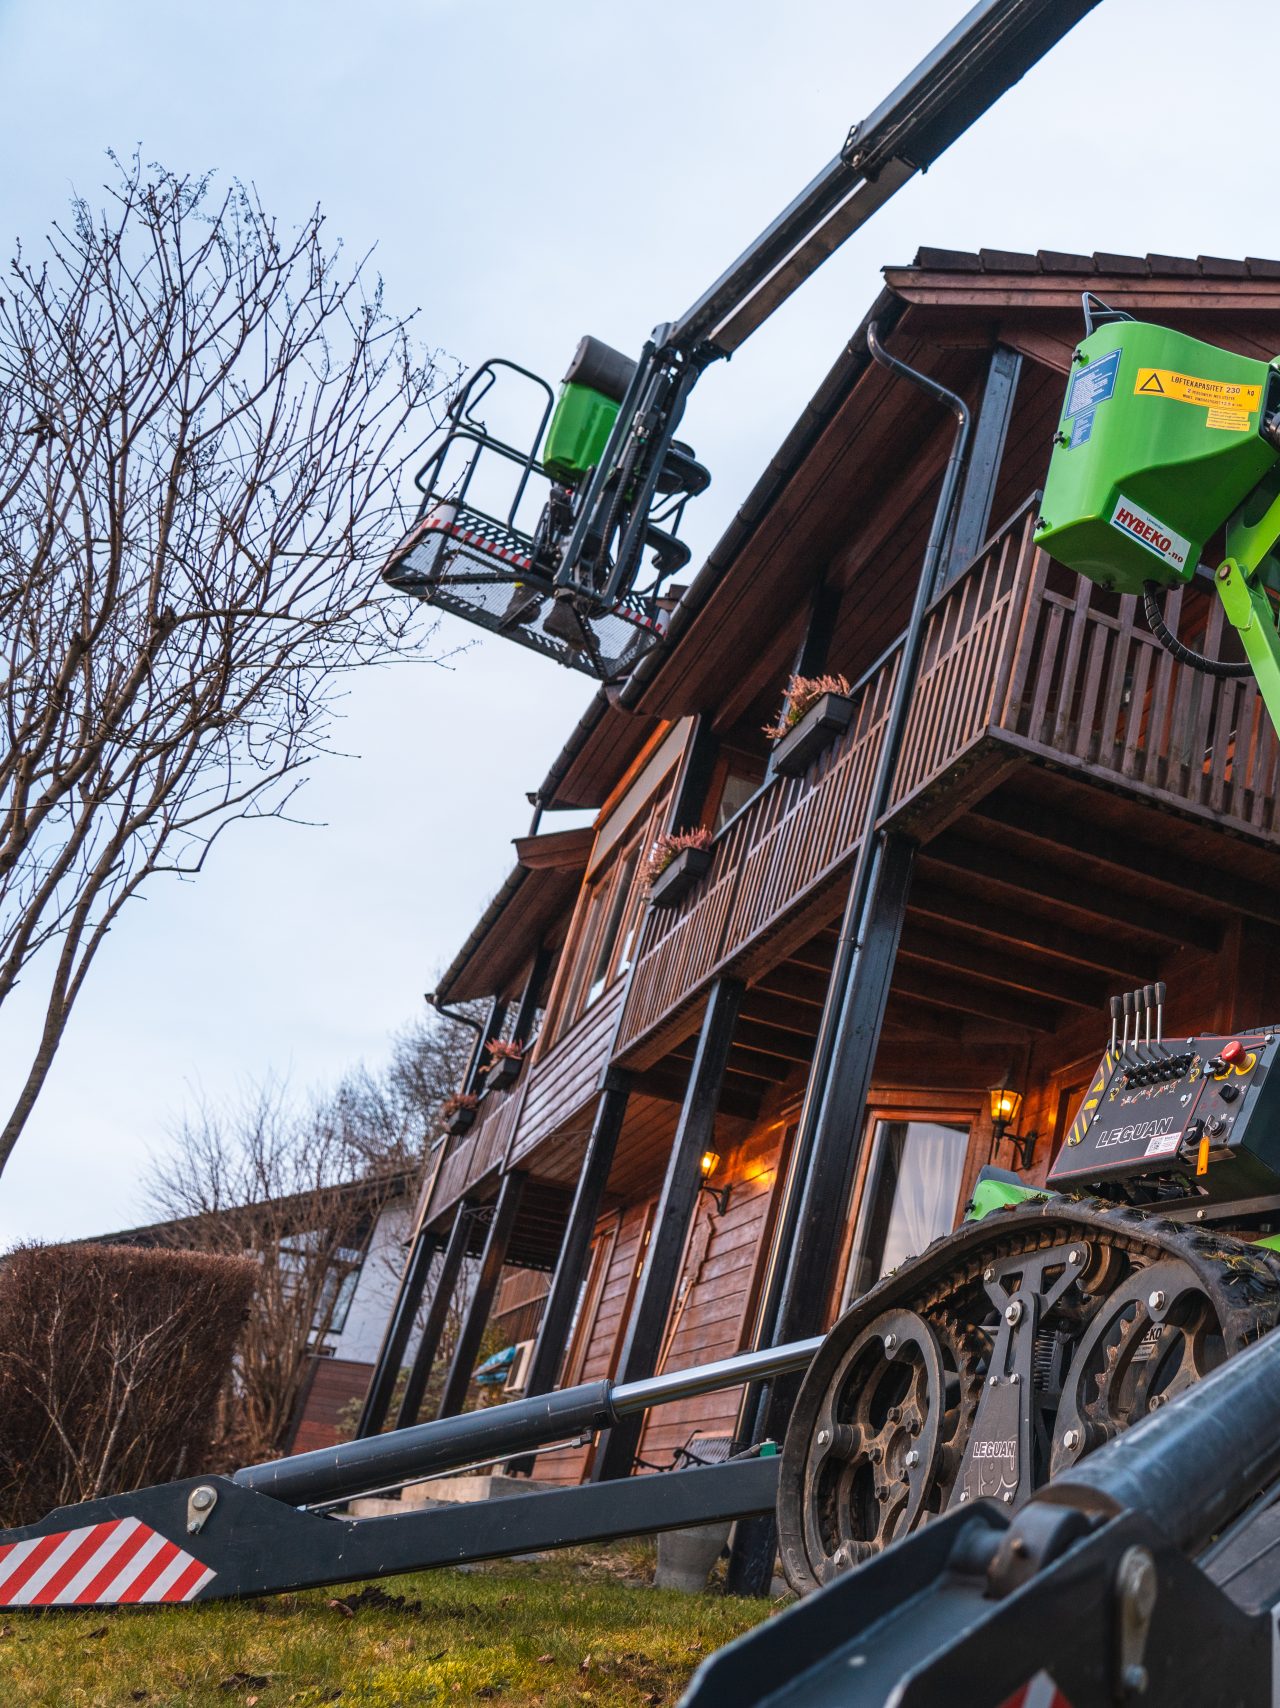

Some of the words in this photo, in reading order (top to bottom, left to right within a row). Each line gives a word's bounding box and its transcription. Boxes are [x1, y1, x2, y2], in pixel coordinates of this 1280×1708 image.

[1171, 376, 1223, 393] LØFTEKAPASITET
[1226, 386, 1241, 394] 230
[1247, 389, 1255, 397] kg
[1095, 1117, 1174, 1149] LEGUAN
[973, 1441, 1017, 1458] LEGUAN
